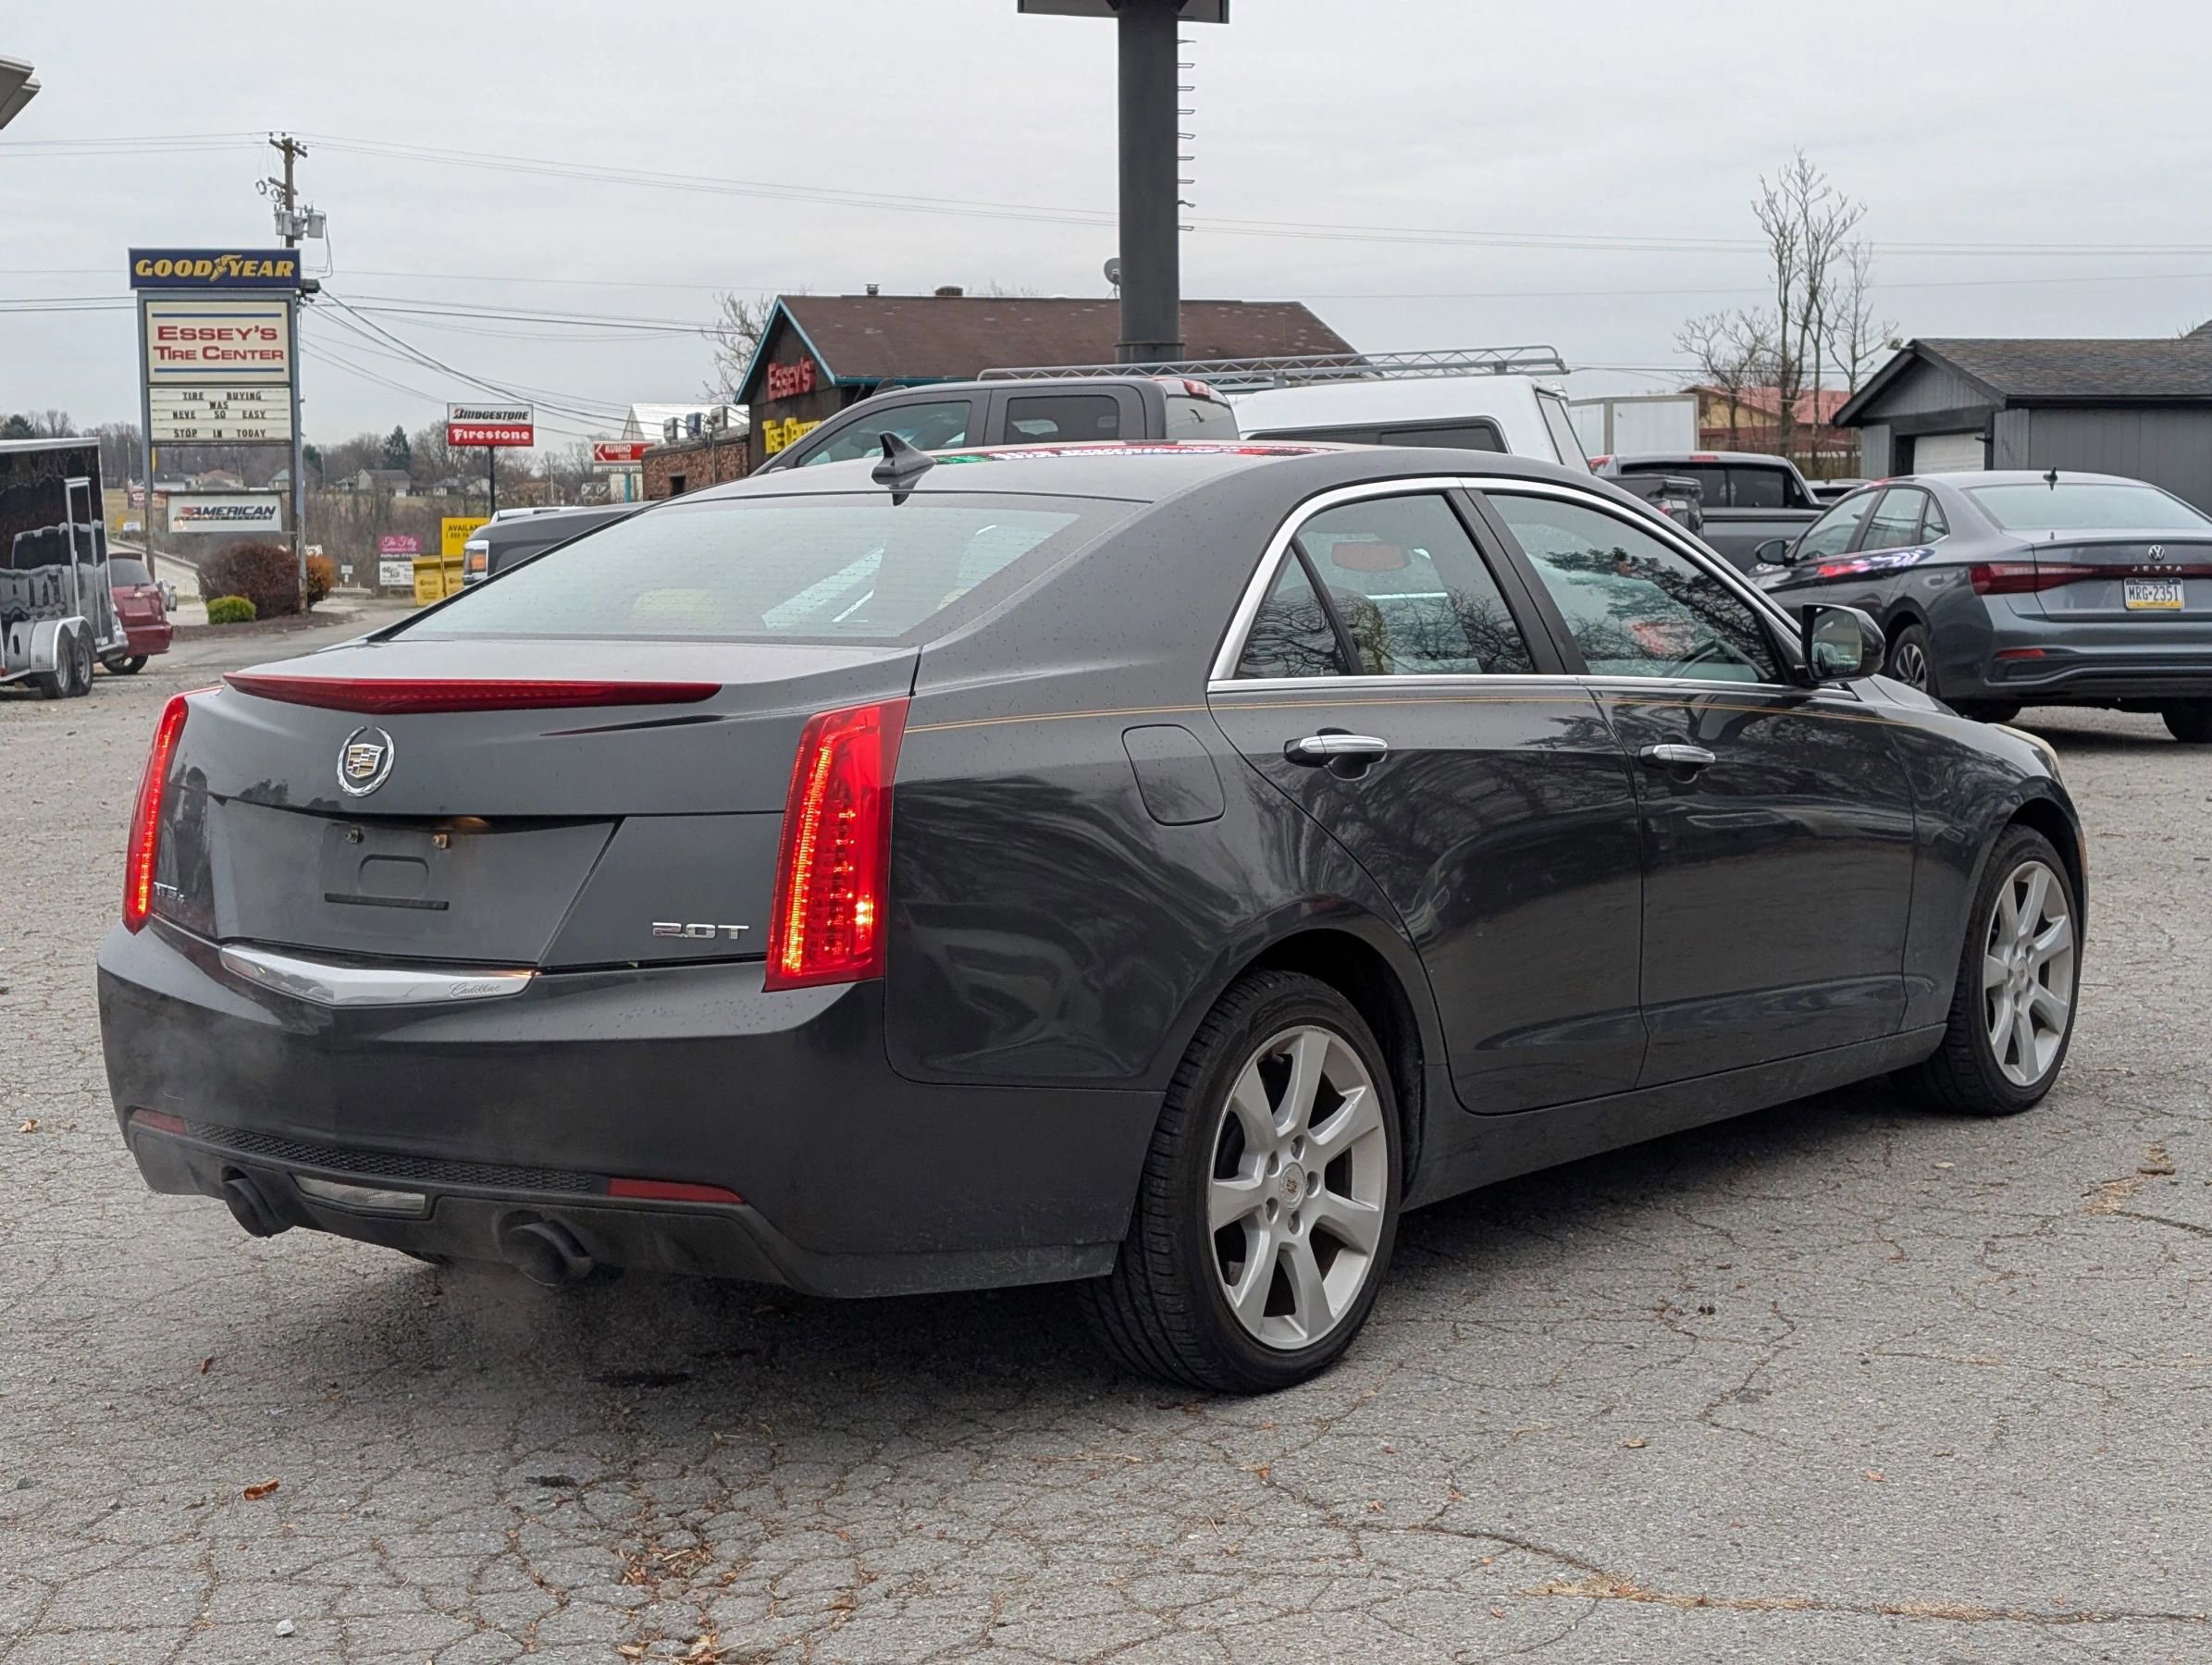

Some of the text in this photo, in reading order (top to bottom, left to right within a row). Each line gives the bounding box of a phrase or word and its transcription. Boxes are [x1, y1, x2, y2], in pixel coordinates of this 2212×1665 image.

[135, 257, 294, 278] GOODYEAR
[157, 326, 278, 340] ESSEY'S
[153, 346, 284, 360] TIRE CENTER
[768, 357, 812, 400] ESSEY'S
[182, 391, 262, 401] TIRE BUYING
[209, 401, 229, 410] WAS
[172, 410, 266, 419] NEVE SO EASY
[452, 408, 529, 421] BRIDGESTONE
[174, 429, 266, 438] STOP IN TODAY
[452, 428, 530, 441] Firestone
[604, 444, 632, 453] KUMHO
[192, 505, 277, 516] AMERICAN
[652, 922, 749, 940] 2.0T
[449, 981, 500, 997] Cadillac
